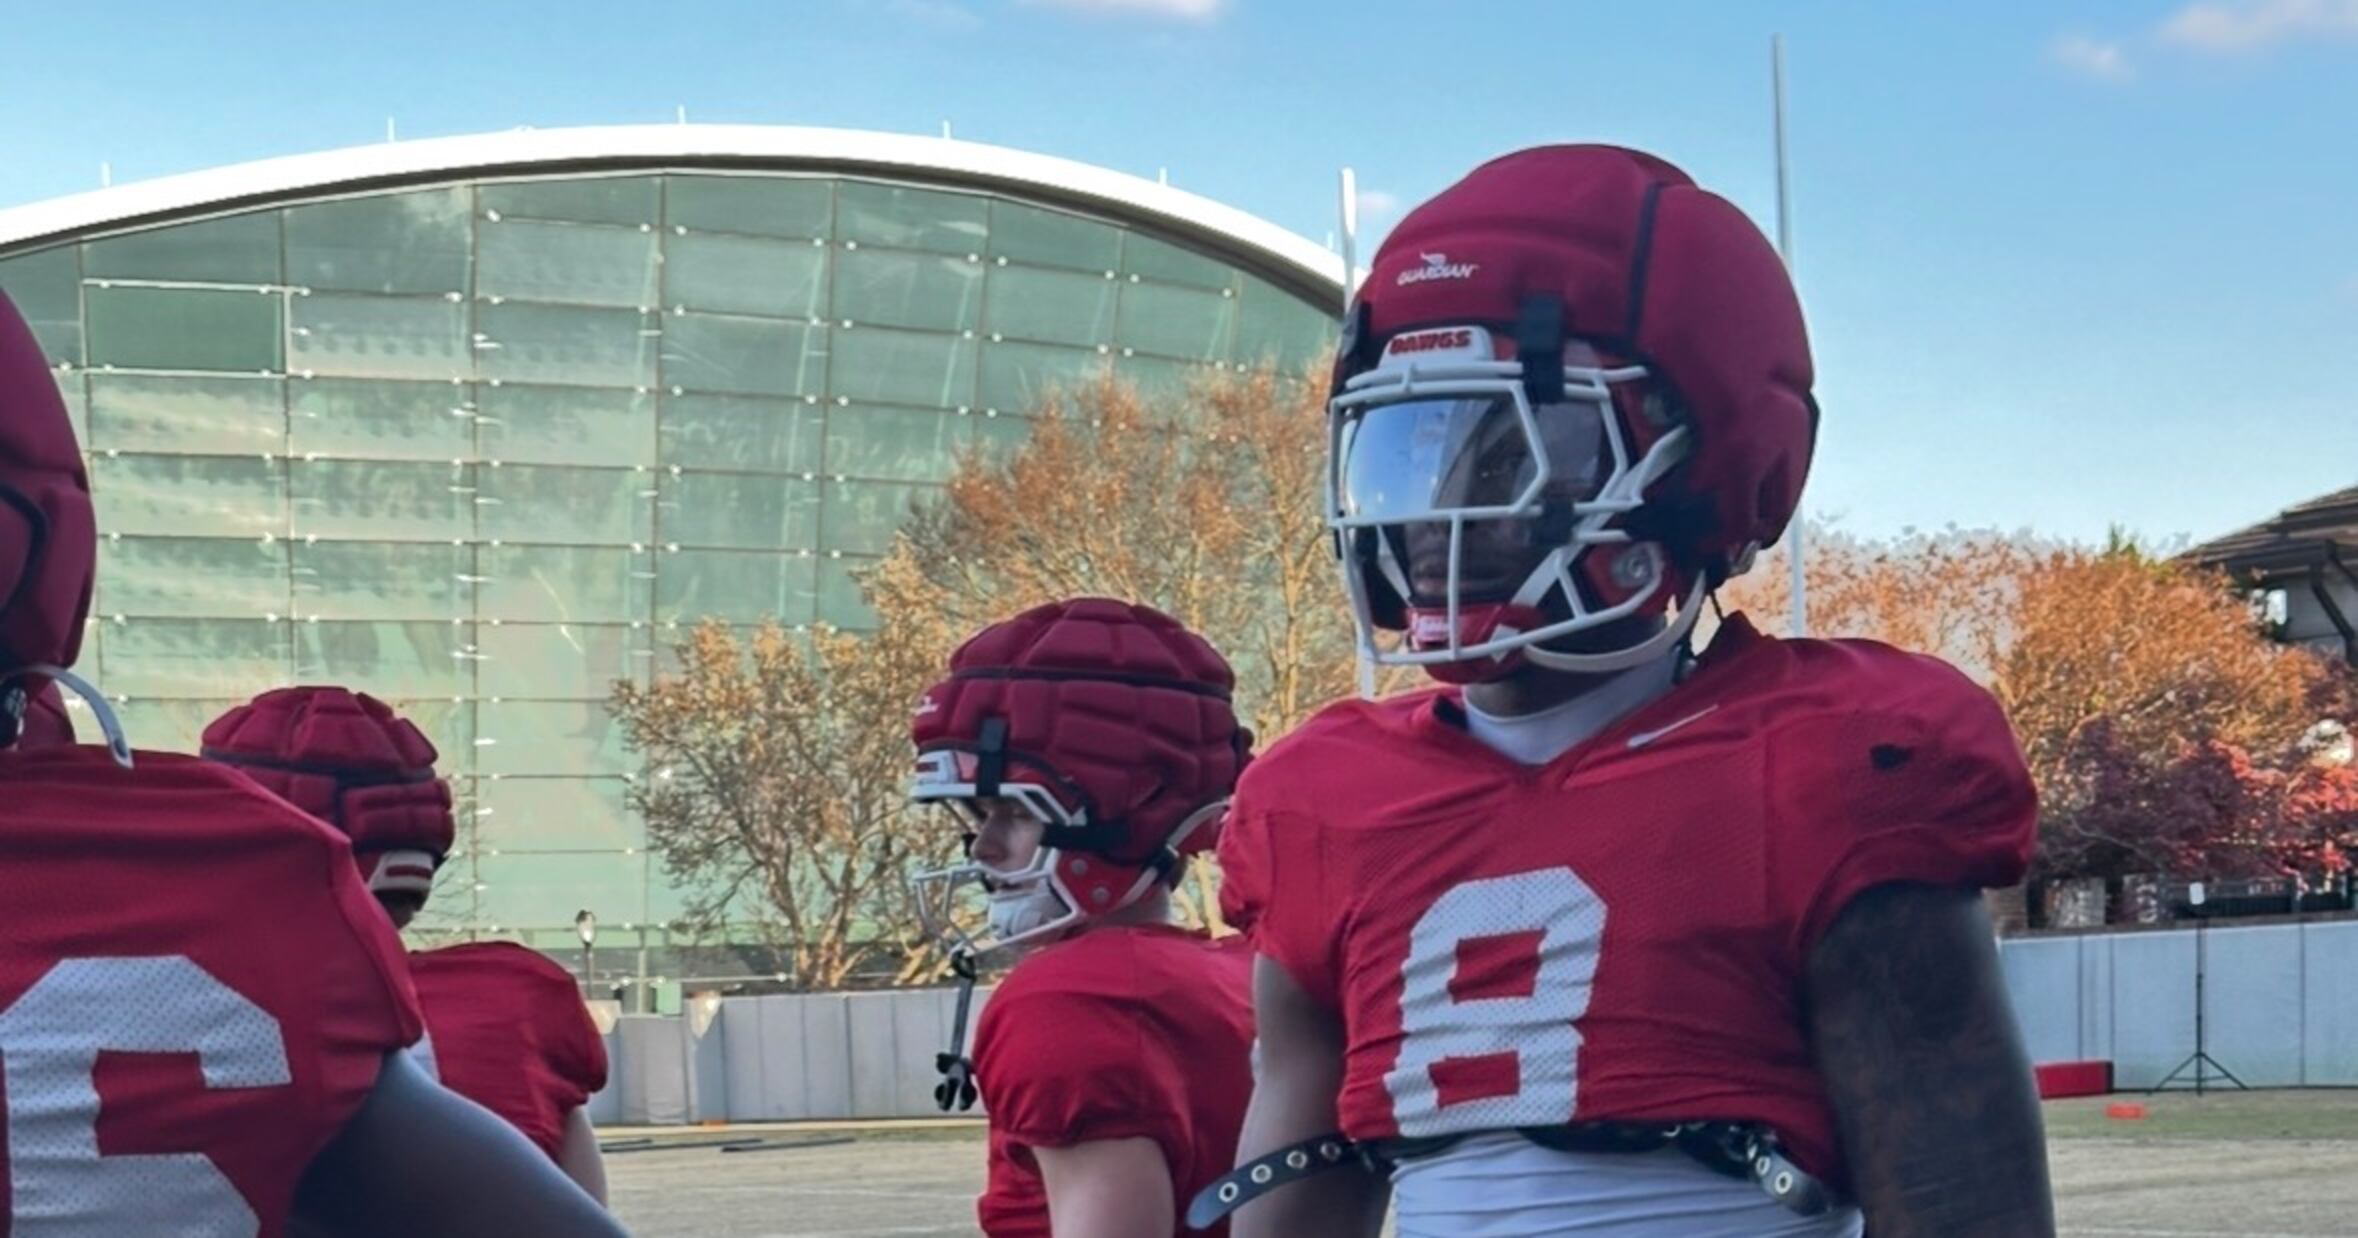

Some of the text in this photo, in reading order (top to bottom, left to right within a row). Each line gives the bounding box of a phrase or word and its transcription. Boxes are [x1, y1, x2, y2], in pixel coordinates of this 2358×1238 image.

[1390, 330, 1472, 354] DAWGS
[1397, 264, 1474, 286] GUARDIAN
[1383, 866, 1608, 1138] 8
[0, 955, 292, 1238] 6
